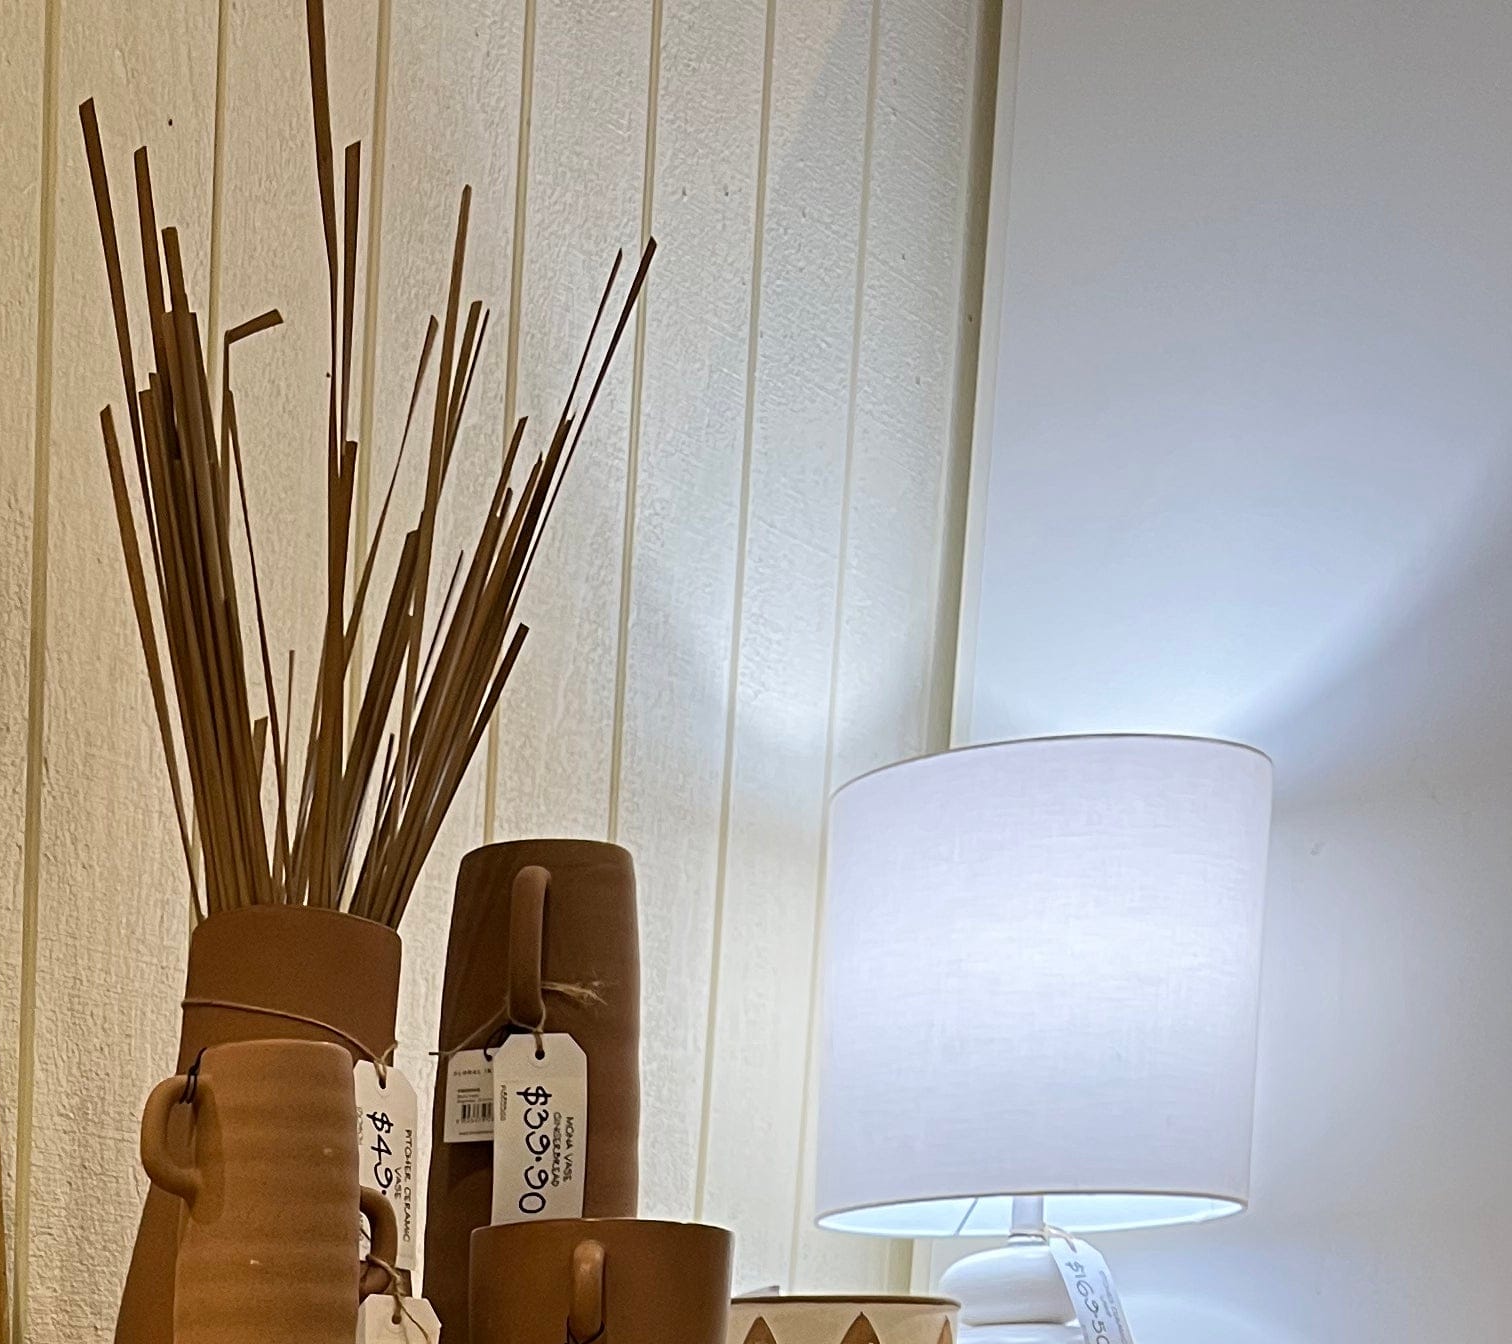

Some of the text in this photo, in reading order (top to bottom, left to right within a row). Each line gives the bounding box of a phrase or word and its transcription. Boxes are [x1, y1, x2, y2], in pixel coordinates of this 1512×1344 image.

[394, 1166, 403, 1199] VASE
[402, 1129, 413, 1243] PITCHER CERAMIC
[516, 1086, 552, 1214] $39.90
[563, 1116, 574, 1182] MONA VASE
